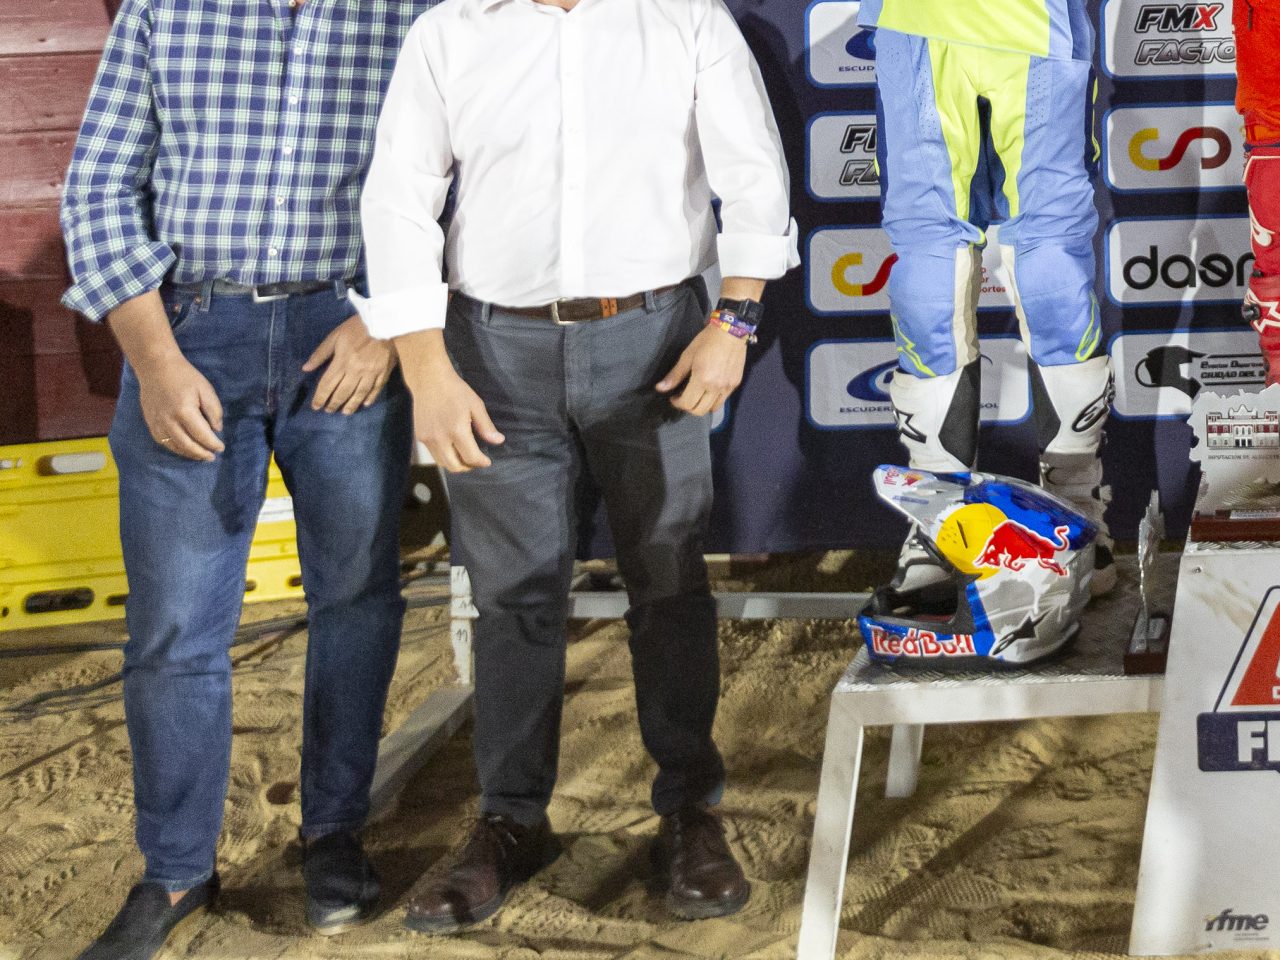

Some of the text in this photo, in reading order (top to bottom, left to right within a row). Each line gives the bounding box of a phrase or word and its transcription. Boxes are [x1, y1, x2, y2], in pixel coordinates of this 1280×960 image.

[1135, 3, 1224, 33] FMX
[1136, 40, 1236, 65] FACTO
[838, 65, 876, 73] ESCUD
[870, 626, 977, 656] Red Bull
[1205, 907, 1270, 932] rfme
